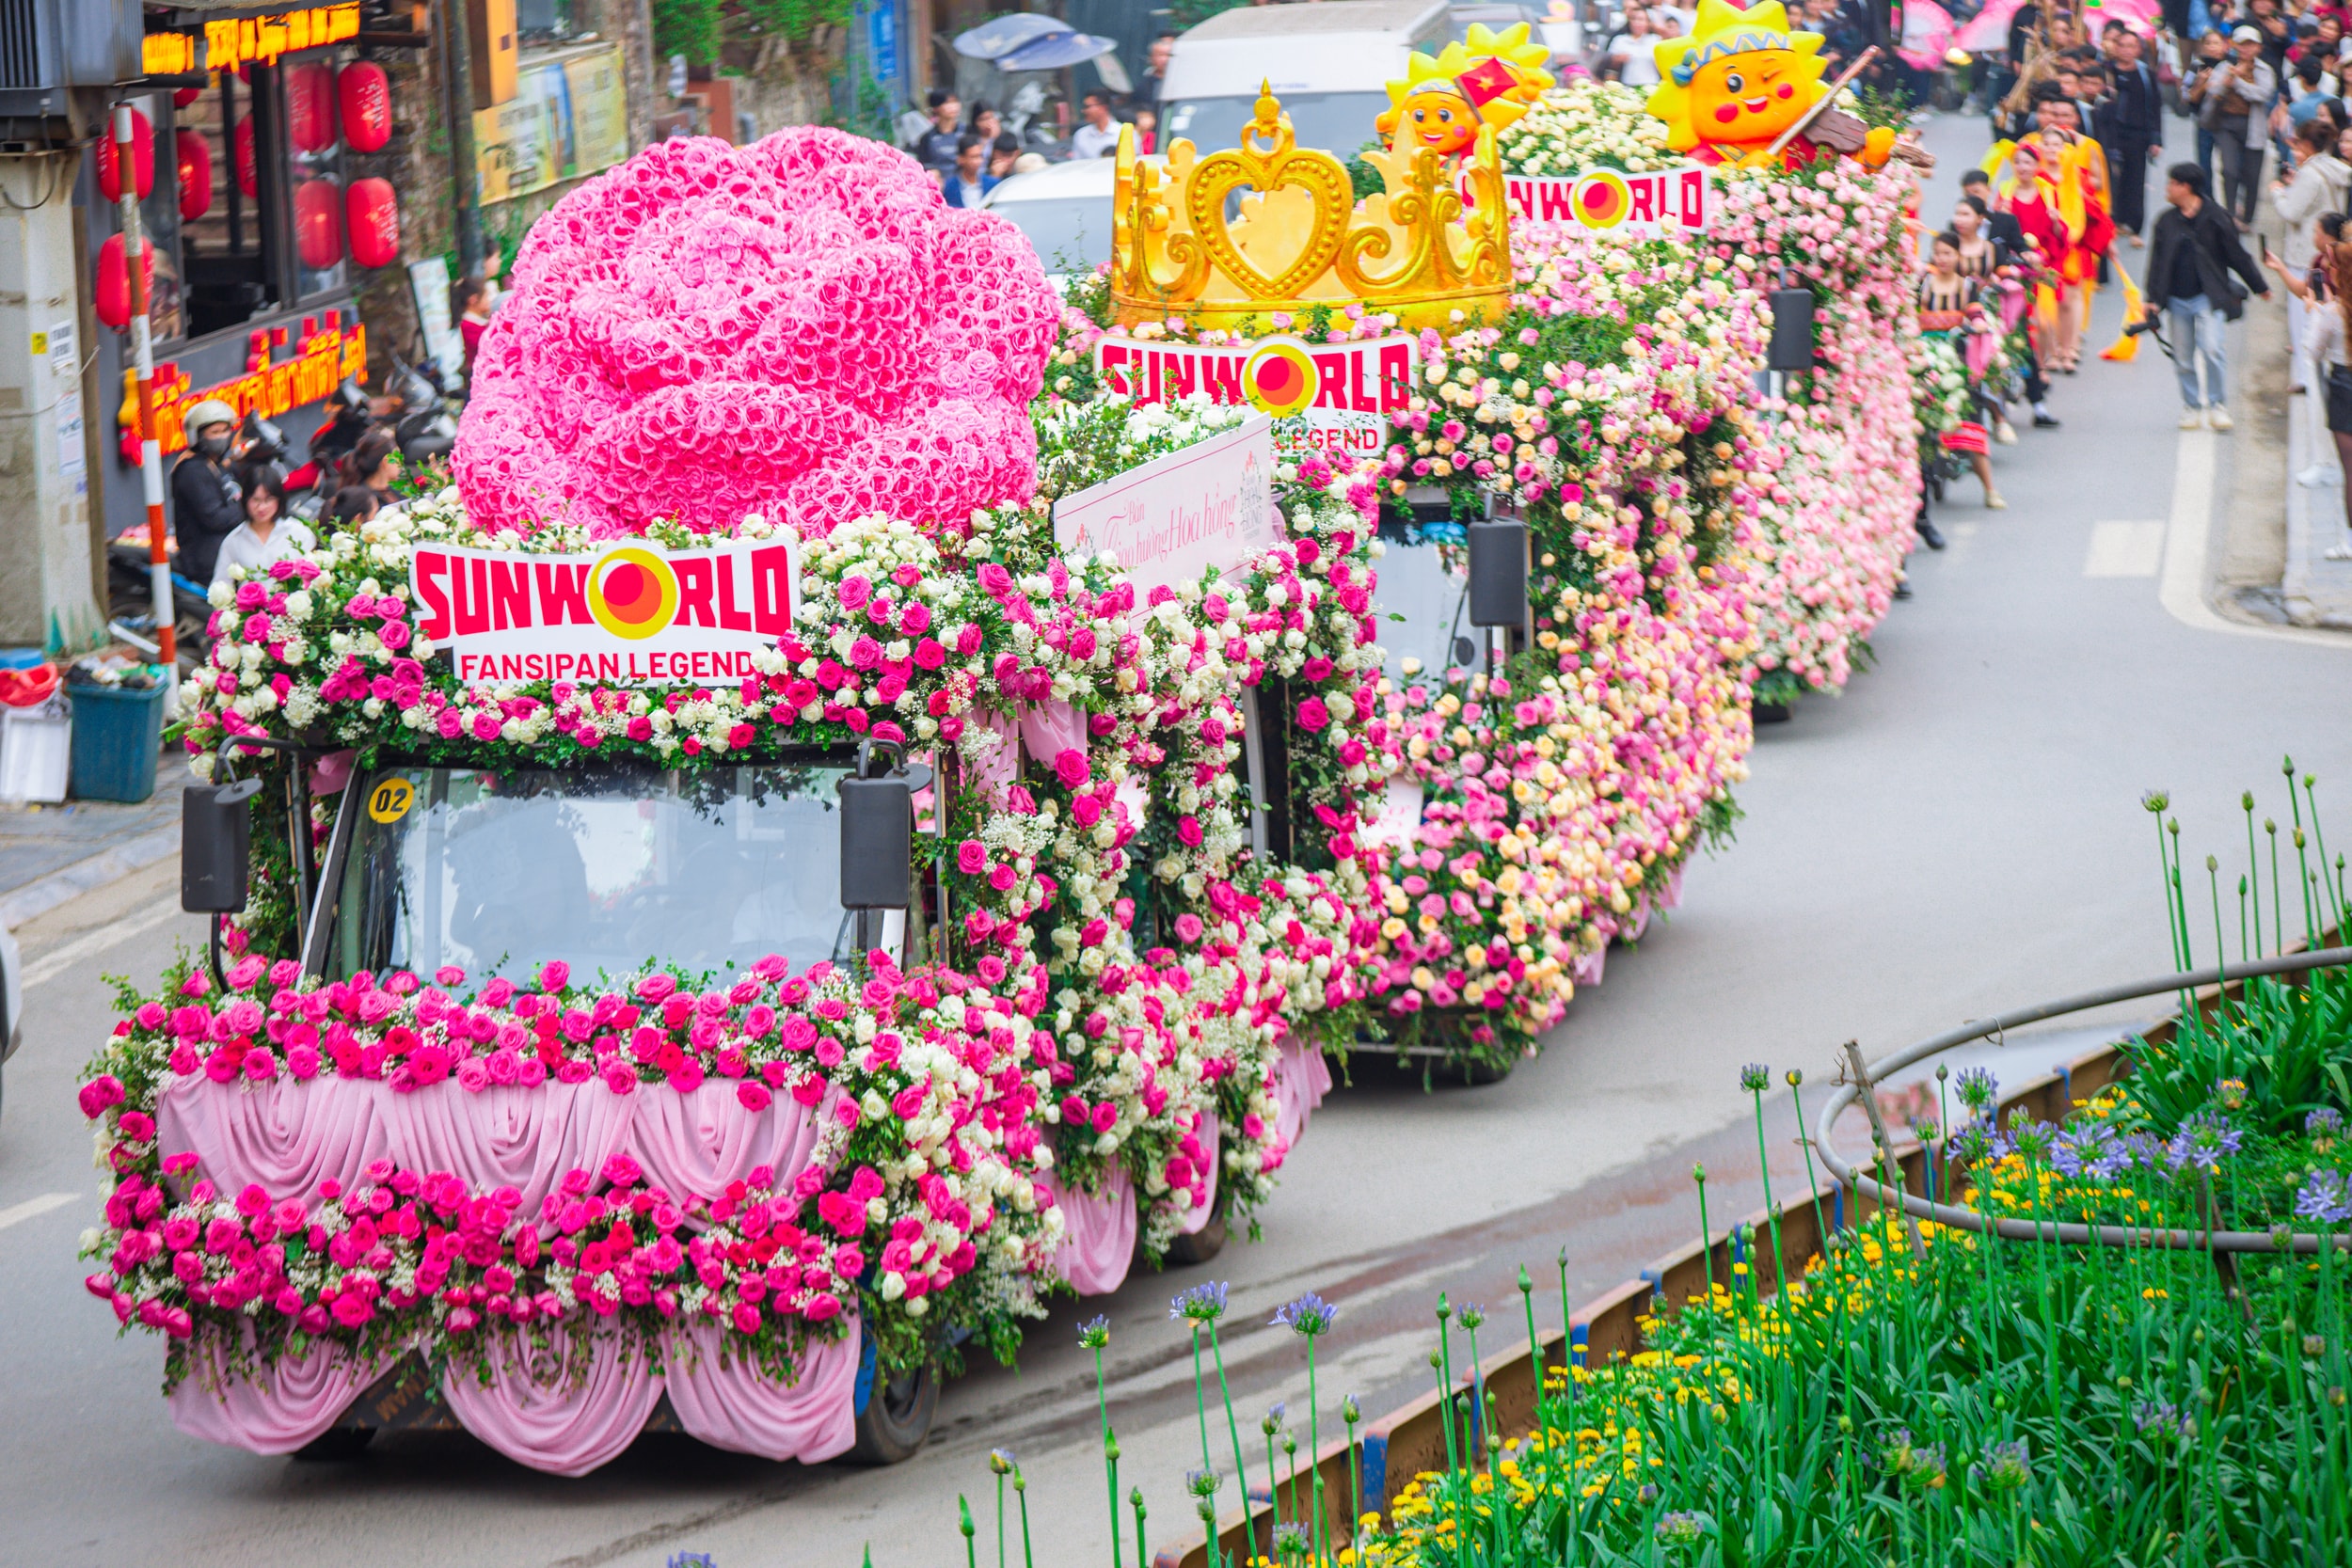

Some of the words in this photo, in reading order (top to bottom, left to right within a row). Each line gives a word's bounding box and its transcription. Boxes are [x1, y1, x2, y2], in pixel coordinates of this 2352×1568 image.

[1462, 170, 1703, 230] NWORLD
[1168, 506, 1200, 551] Hoa
[416, 545, 791, 641] SUNWORLD
[460, 652, 619, 681] FANSIPAN
[629, 650, 755, 680] LEGEND
[375, 787, 408, 814] 02
